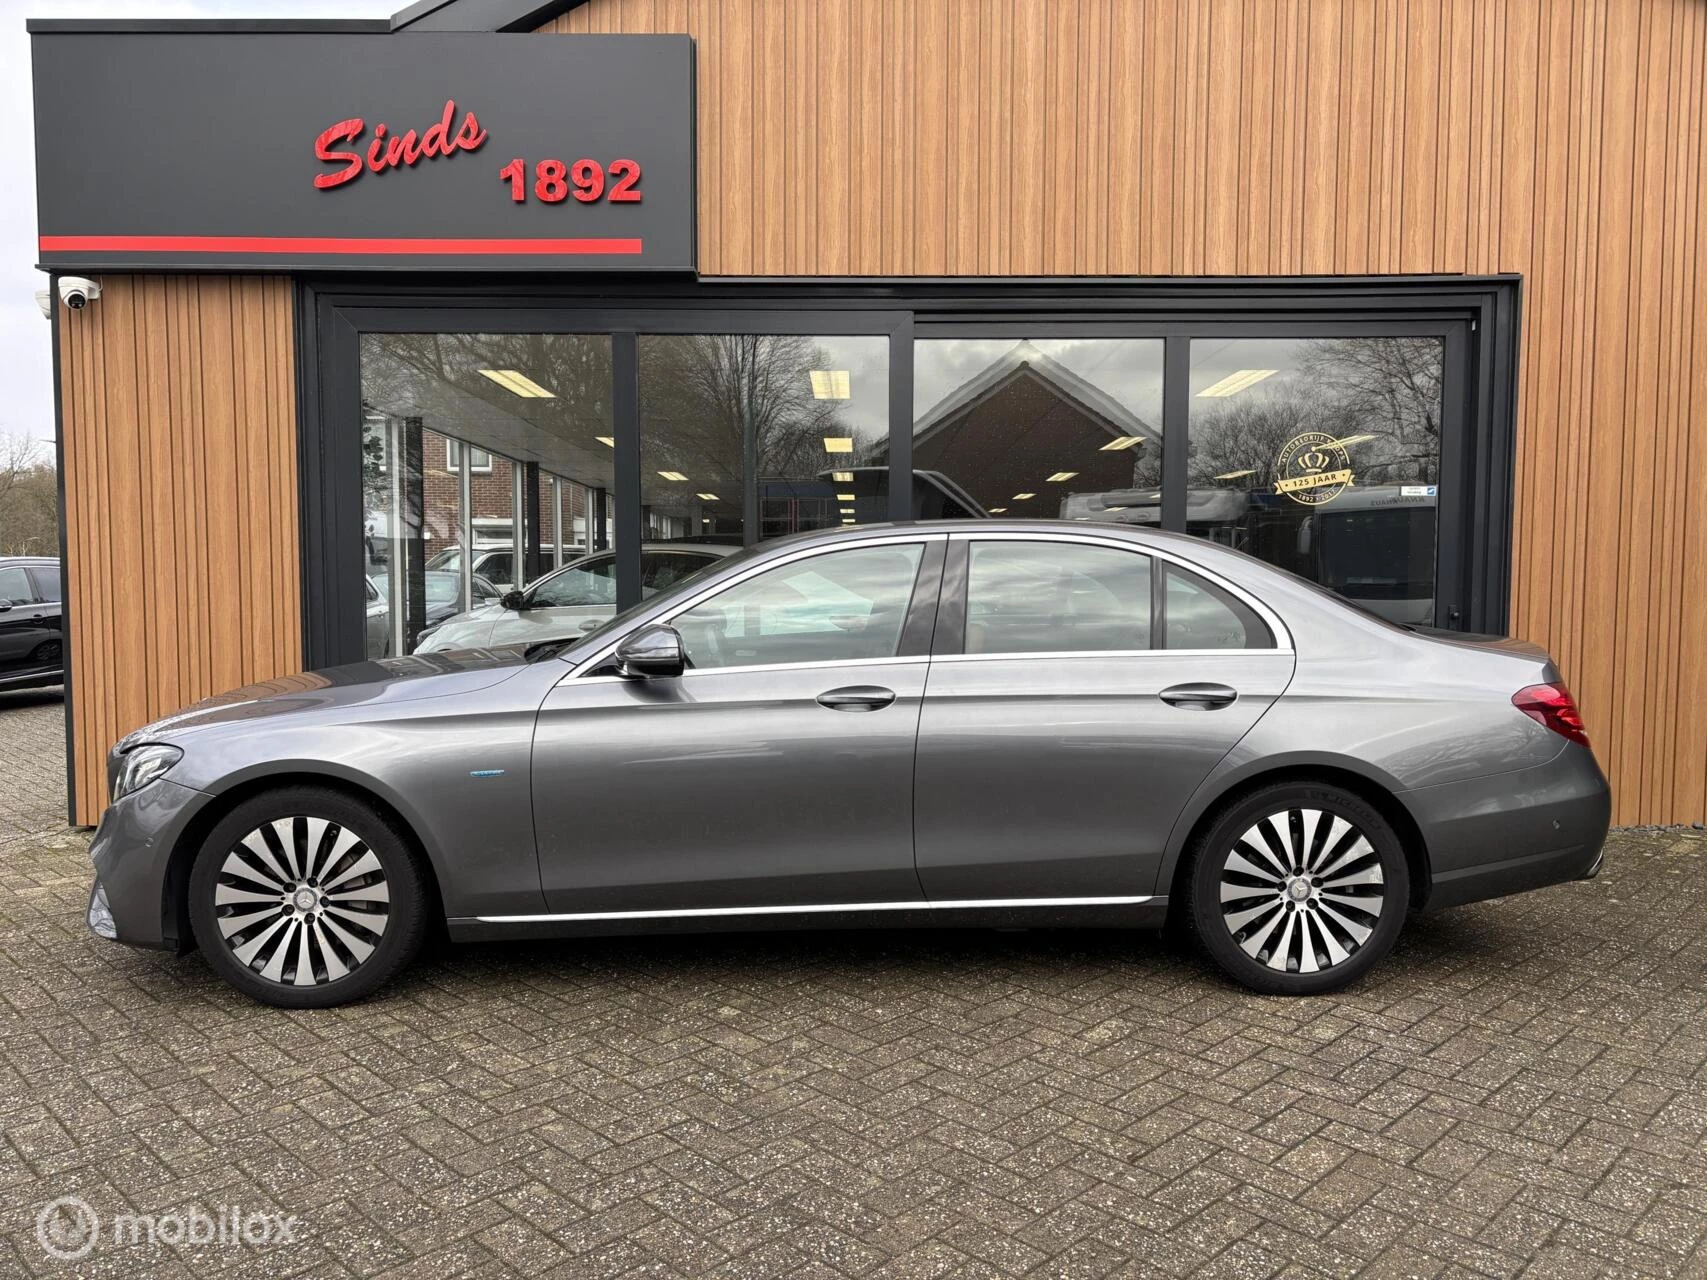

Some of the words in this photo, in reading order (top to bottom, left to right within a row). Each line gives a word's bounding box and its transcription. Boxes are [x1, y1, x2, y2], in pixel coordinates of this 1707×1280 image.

[313, 100, 487, 190] Sinds
[500, 158, 642, 203] 1892
[1293, 478, 1309, 487] 125
[1313, 473, 1337, 485] JAAR
[1298, 493, 1314, 502] 1892
